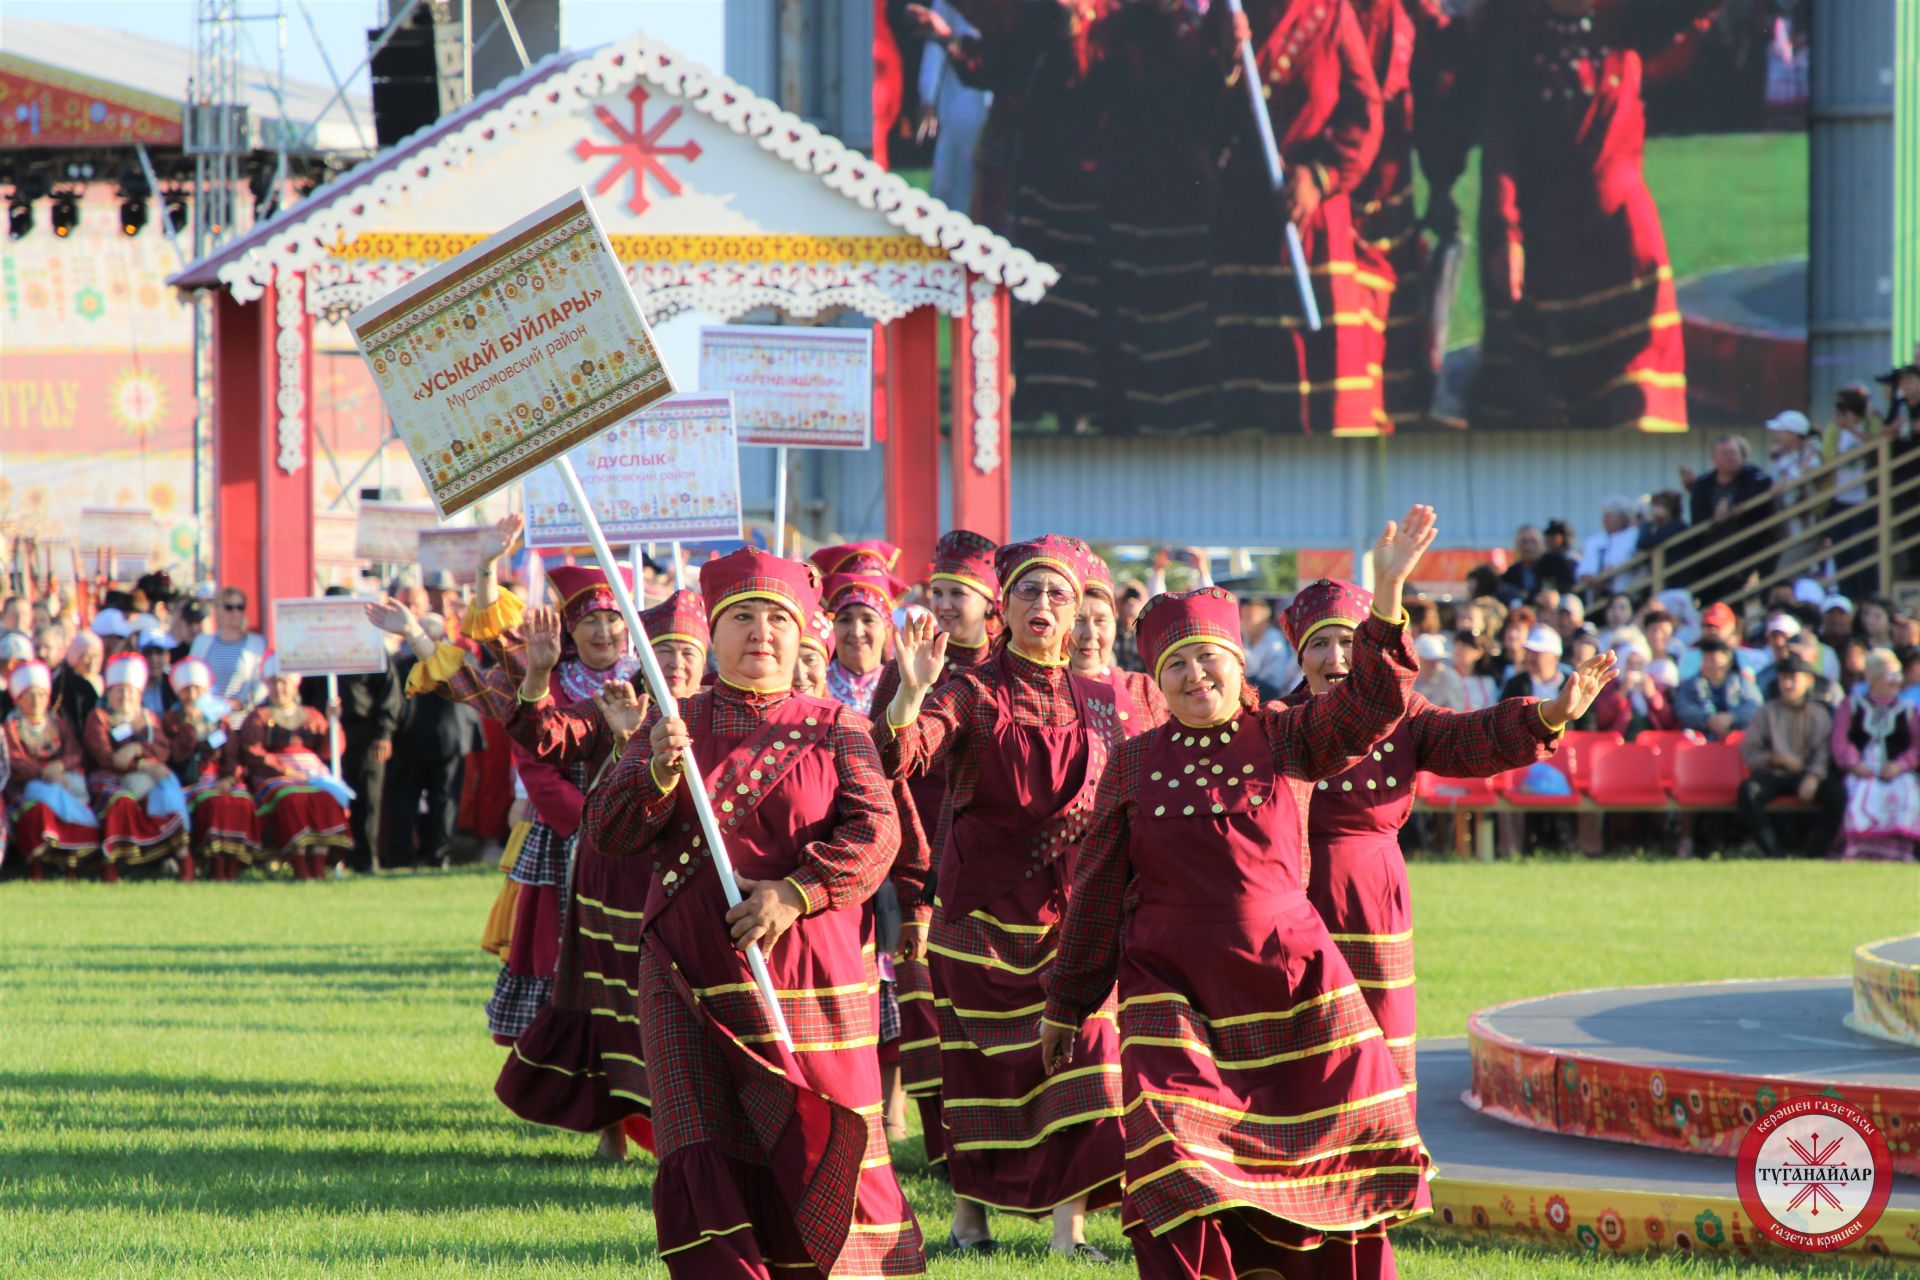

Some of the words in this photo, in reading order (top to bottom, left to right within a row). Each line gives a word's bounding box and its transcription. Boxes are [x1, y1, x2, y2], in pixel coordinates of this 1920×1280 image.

[413, 339, 499, 401] «УСЫКАЙ
[499, 289, 602, 353] БУЙЛАРЫ»
[446, 347, 544, 411] Муслюмовский
[545, 324, 588, 359] район
[576, 470, 657, 485] услюмовский
[586, 453, 676, 470] «ДУСЛЫК»
